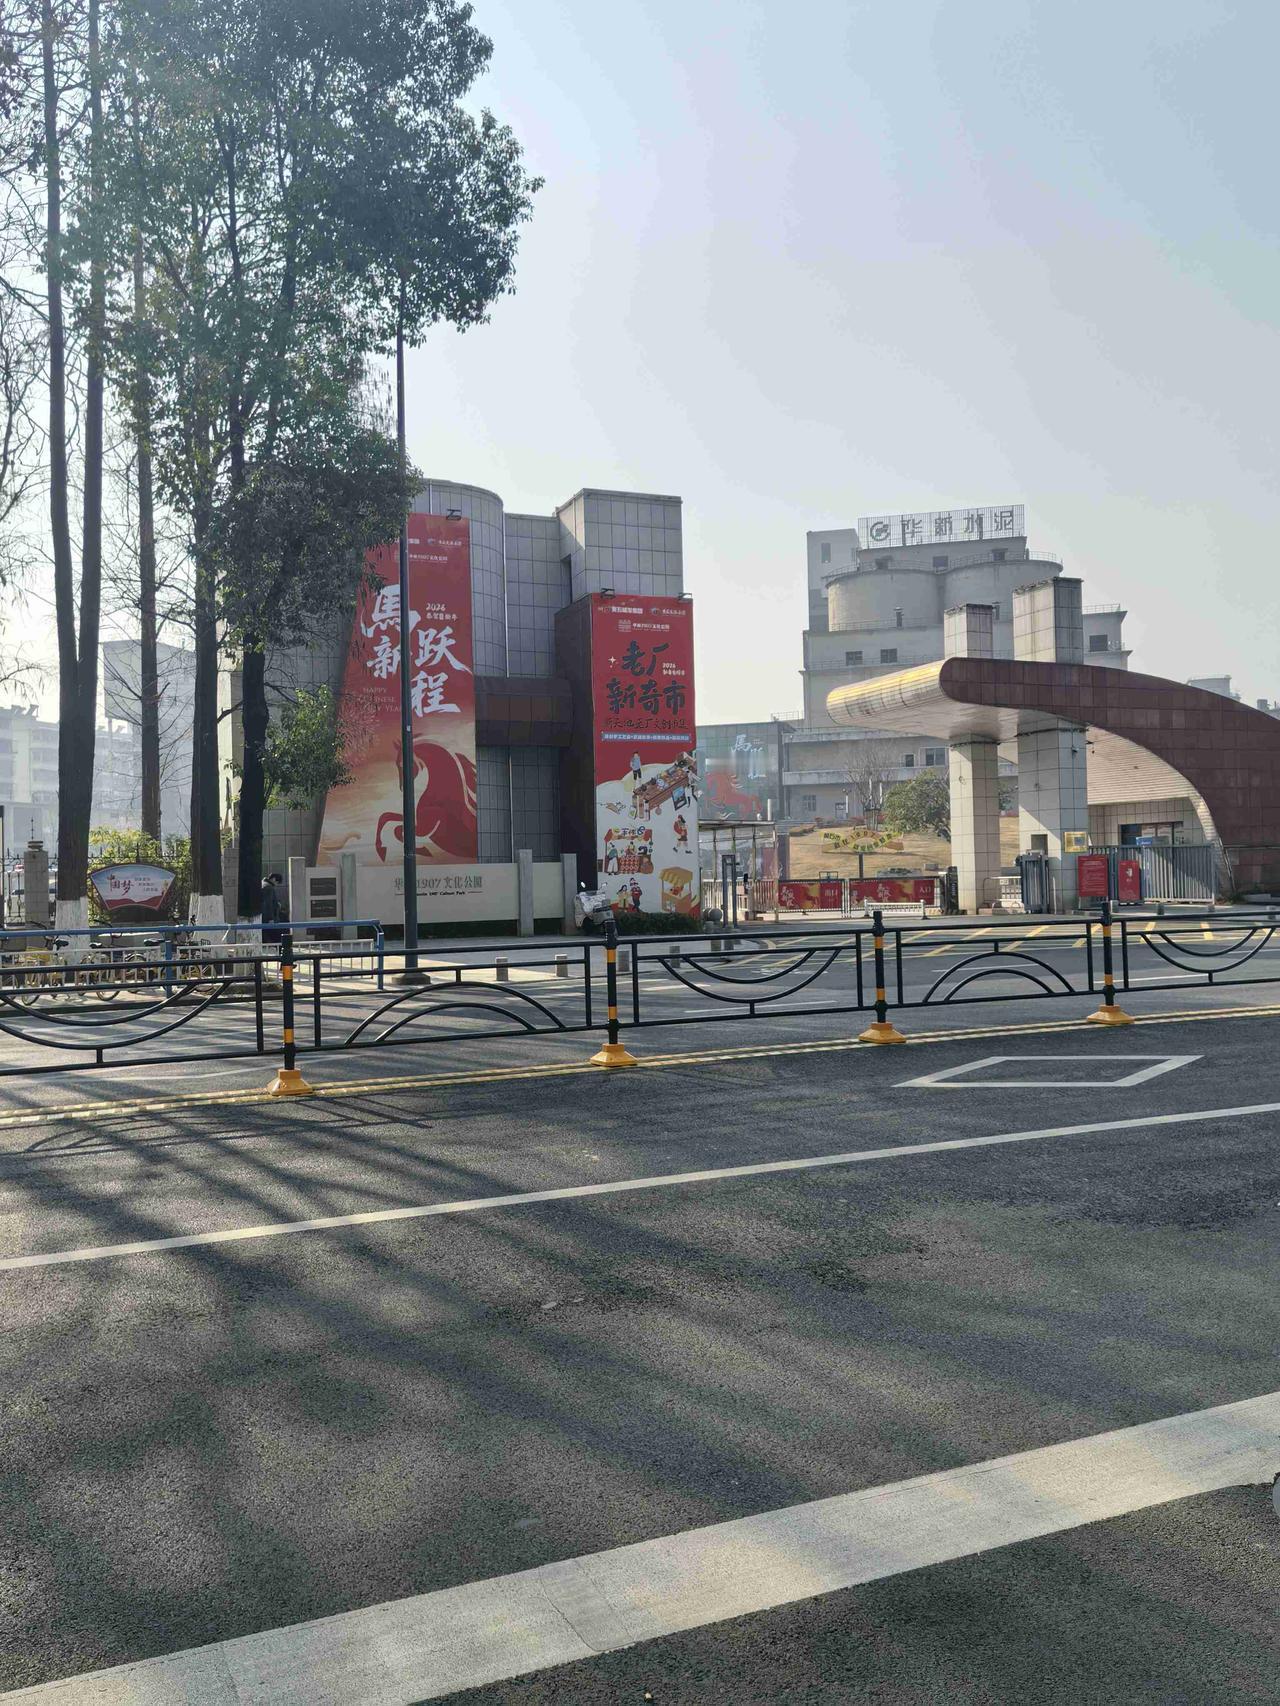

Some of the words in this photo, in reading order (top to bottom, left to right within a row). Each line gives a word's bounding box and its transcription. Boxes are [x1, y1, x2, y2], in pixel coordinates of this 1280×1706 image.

[900, 510, 1013, 539] 华新水泥
[426, 602, 446, 611] 2026
[622, 640, 670, 677] 老厂
[606, 678, 687, 716] 新奇市
[107, 874, 135, 897] 中国梦
[394, 876, 483, 890] 华1907文化公园
